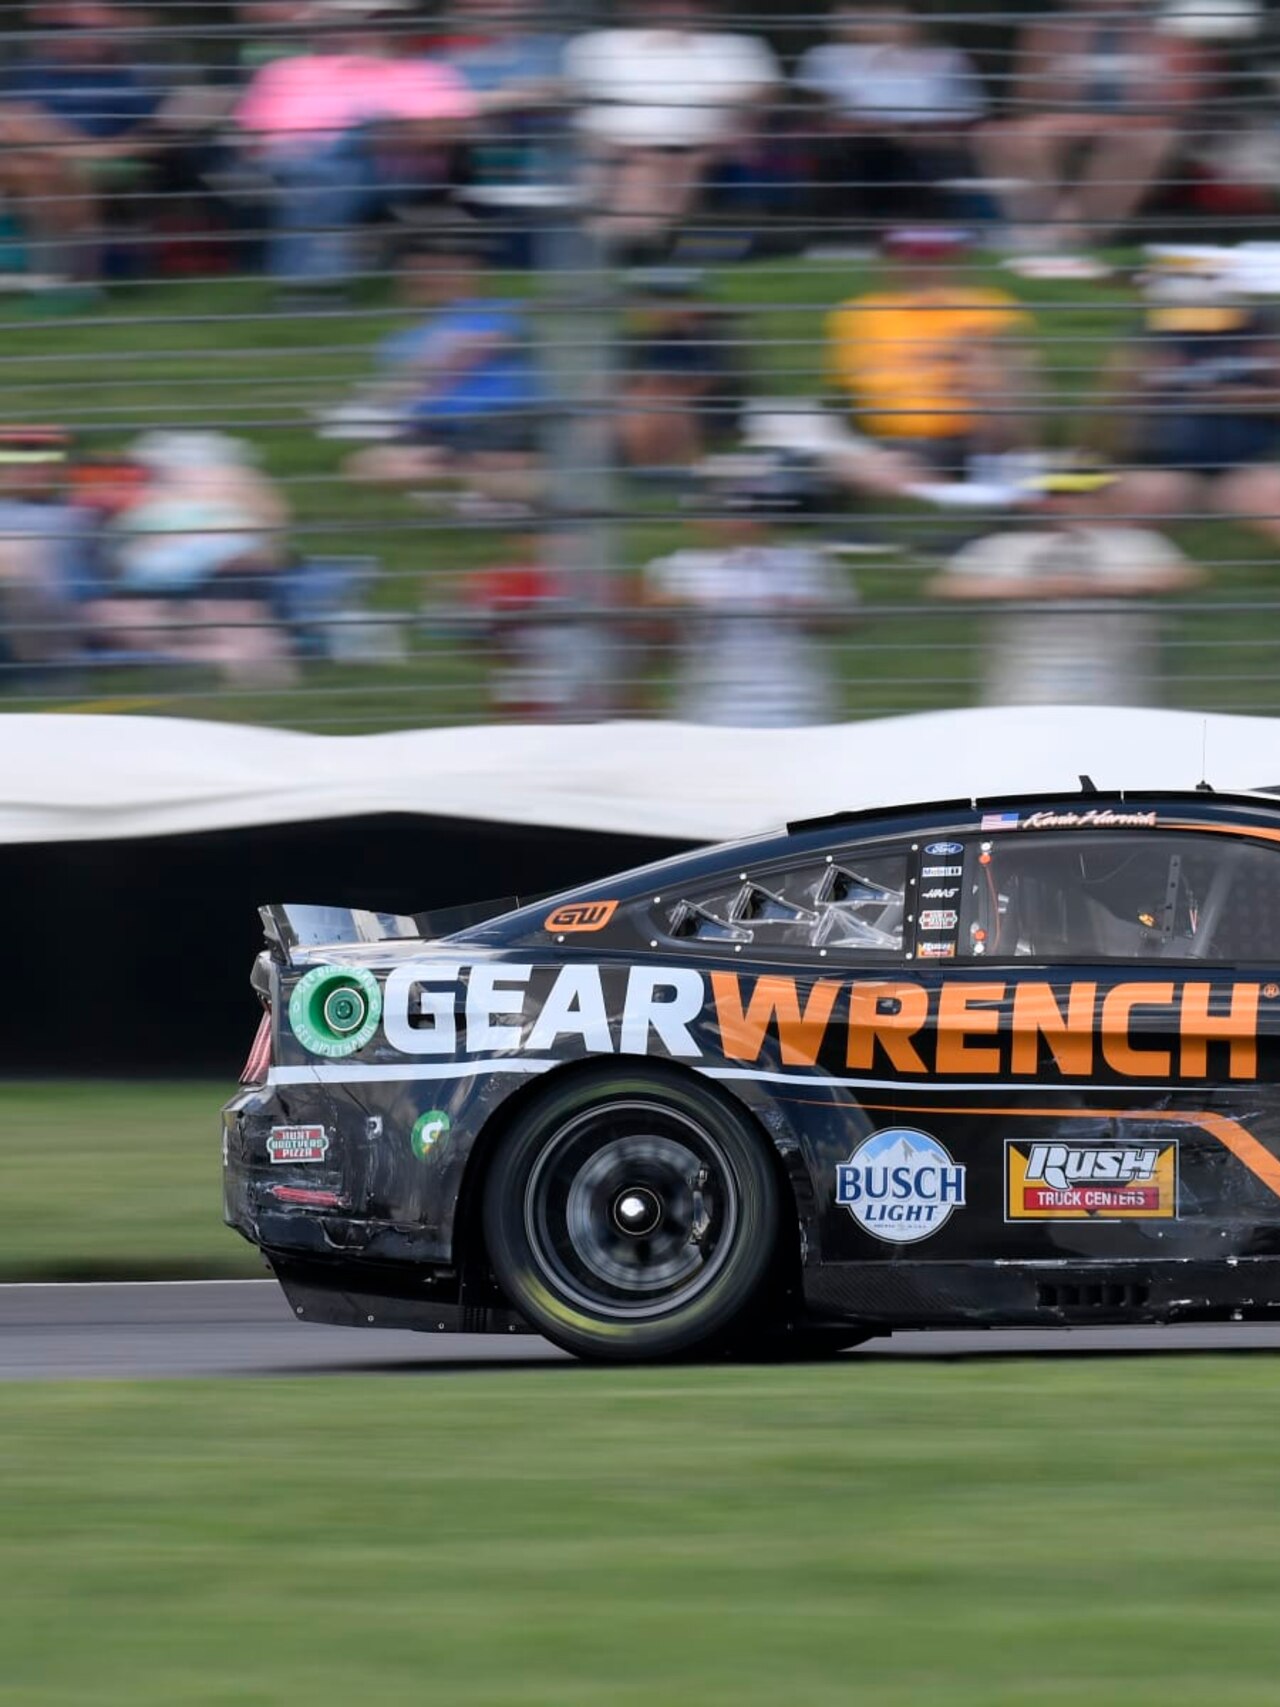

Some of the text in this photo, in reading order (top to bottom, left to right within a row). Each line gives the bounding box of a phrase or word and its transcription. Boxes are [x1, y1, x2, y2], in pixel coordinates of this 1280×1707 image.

[282, 1148, 312, 1158] PIZZA
[838, 1166, 963, 1202] BUSCH
[1037, 1191, 1146, 1206] TRUCK CENTERS
[864, 1204, 938, 1221] LIGHT
